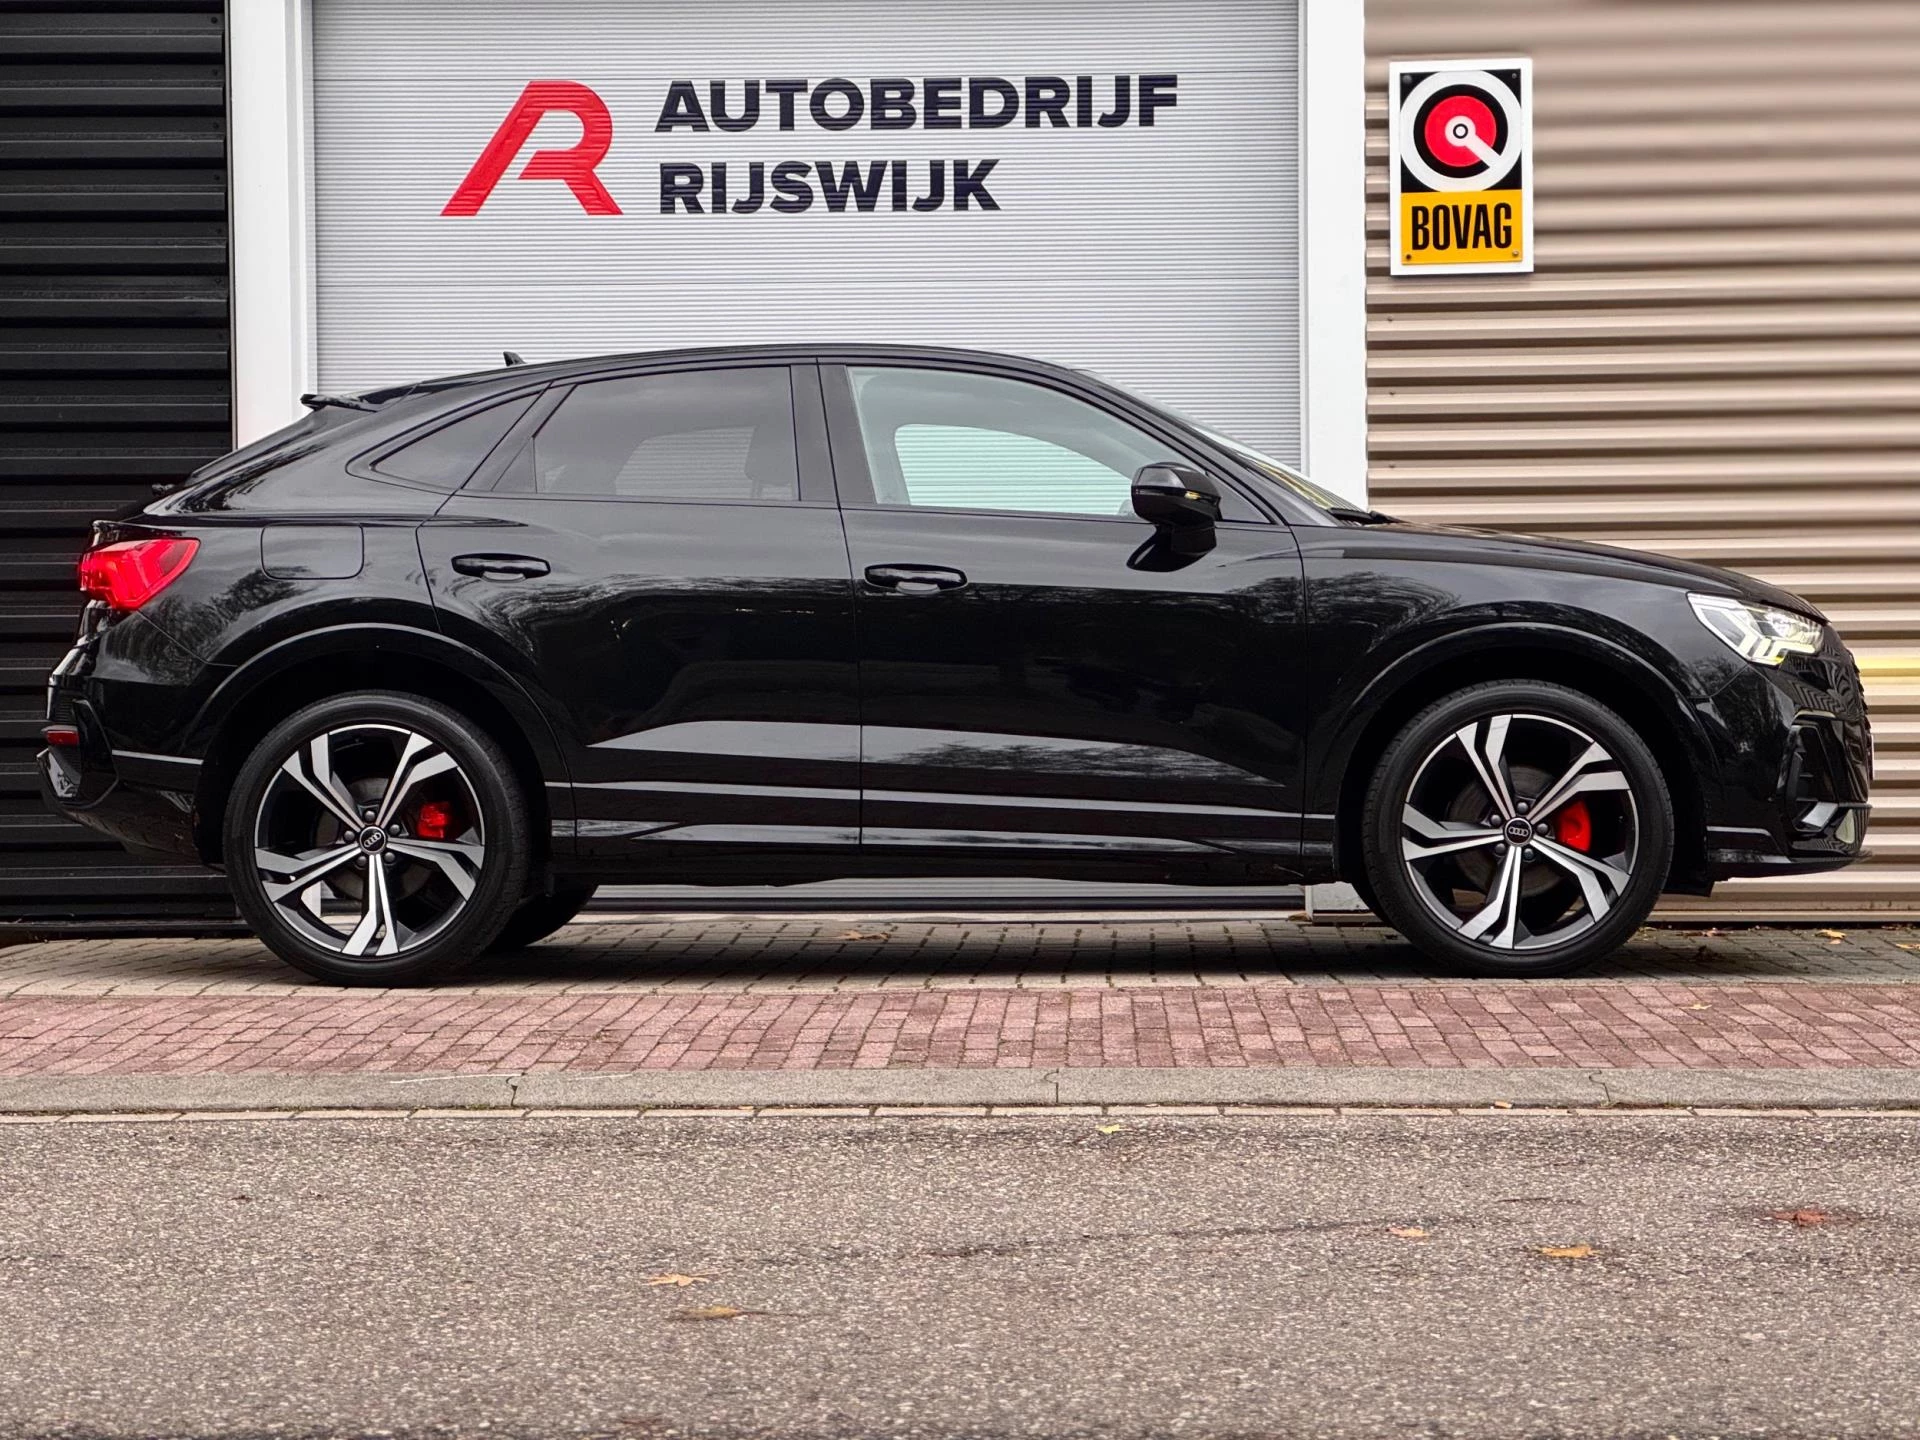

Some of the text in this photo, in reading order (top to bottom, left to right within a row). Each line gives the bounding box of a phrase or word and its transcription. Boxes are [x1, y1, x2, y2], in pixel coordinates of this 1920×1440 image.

[654, 75, 1178, 132] AUTOBEDRIJF
[659, 158, 1002, 214] RIJSWIJK
[1411, 202, 1512, 251] BOVAG
